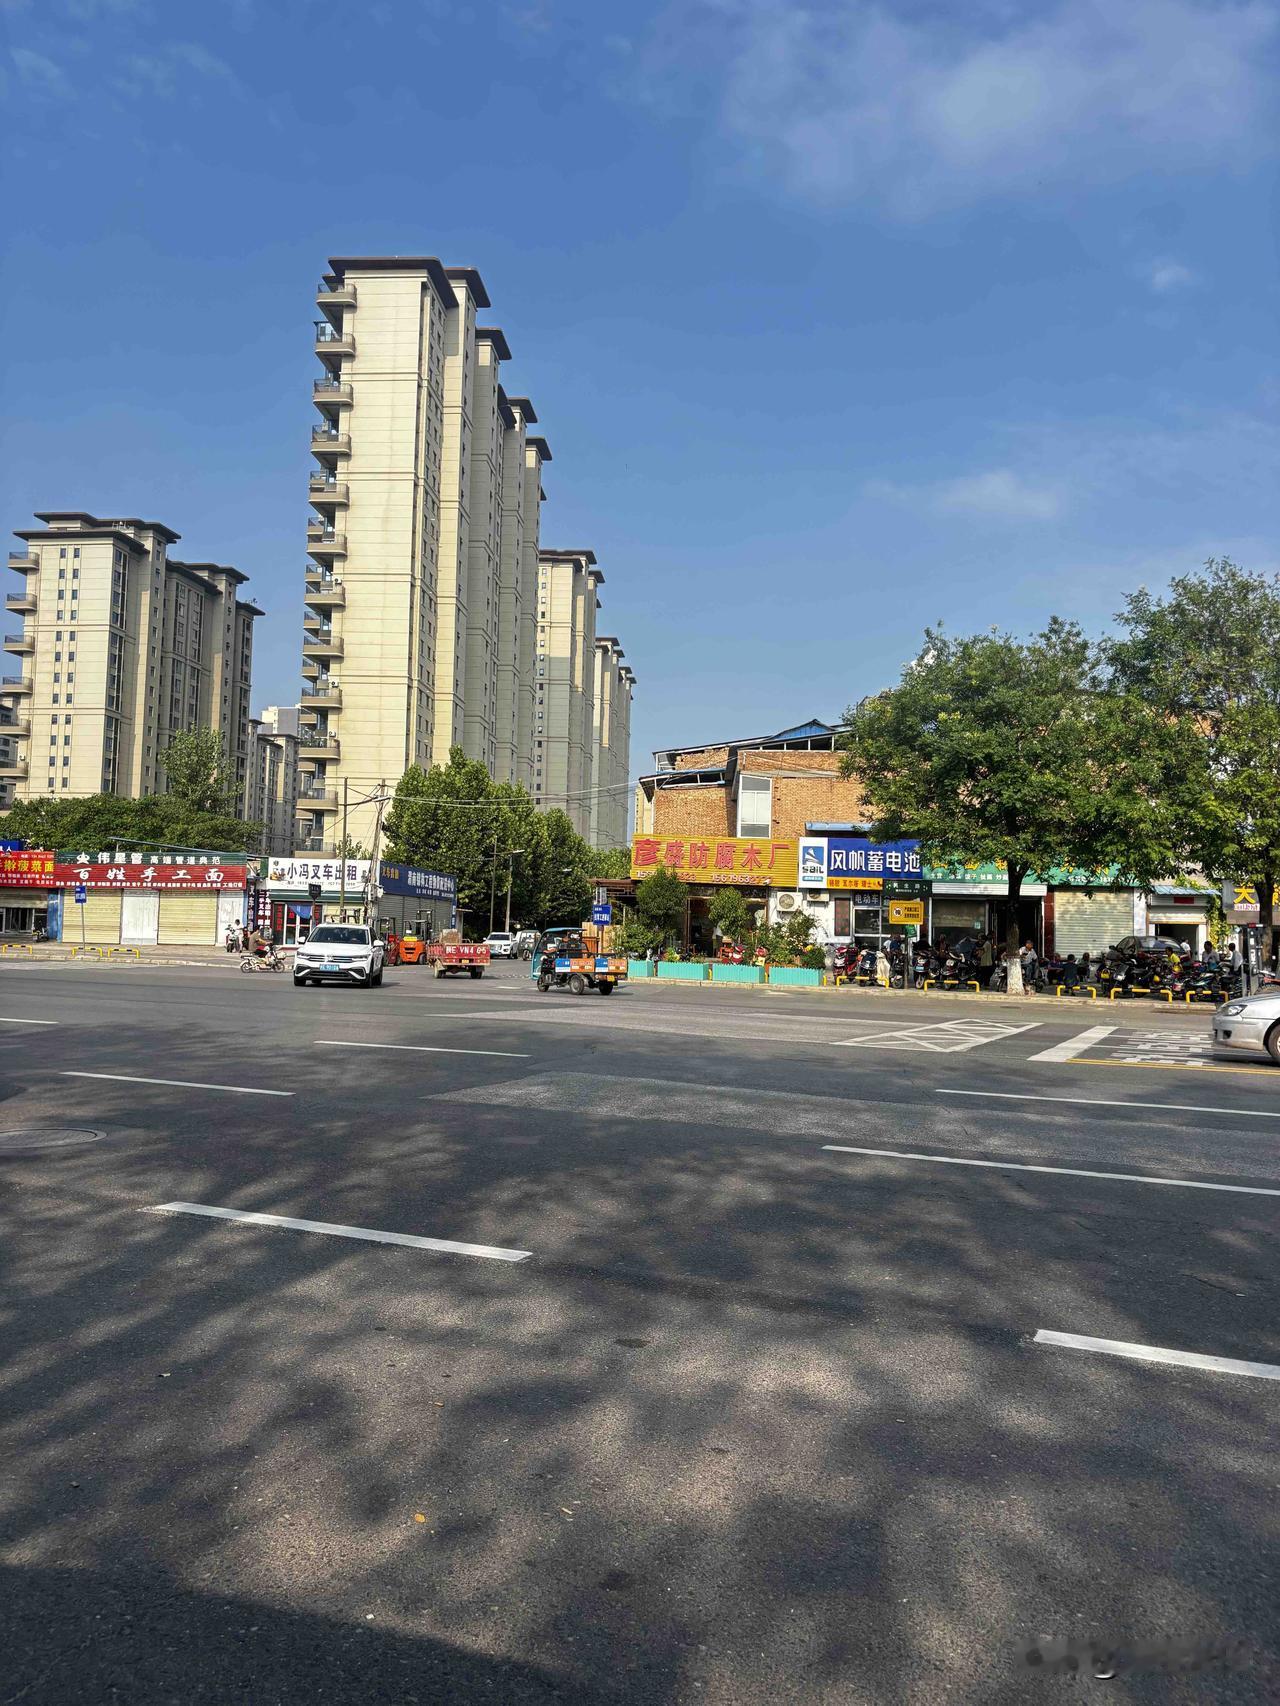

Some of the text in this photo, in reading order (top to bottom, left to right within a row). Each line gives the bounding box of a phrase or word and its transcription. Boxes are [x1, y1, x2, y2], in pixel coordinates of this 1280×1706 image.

[97, 852, 143, 864] 伟星管
[830, 850, 920, 873] 风帆蓄电池
[72, 867, 224, 882] 百姓手工面
[287, 862, 357, 881] 小冯叉车出租
